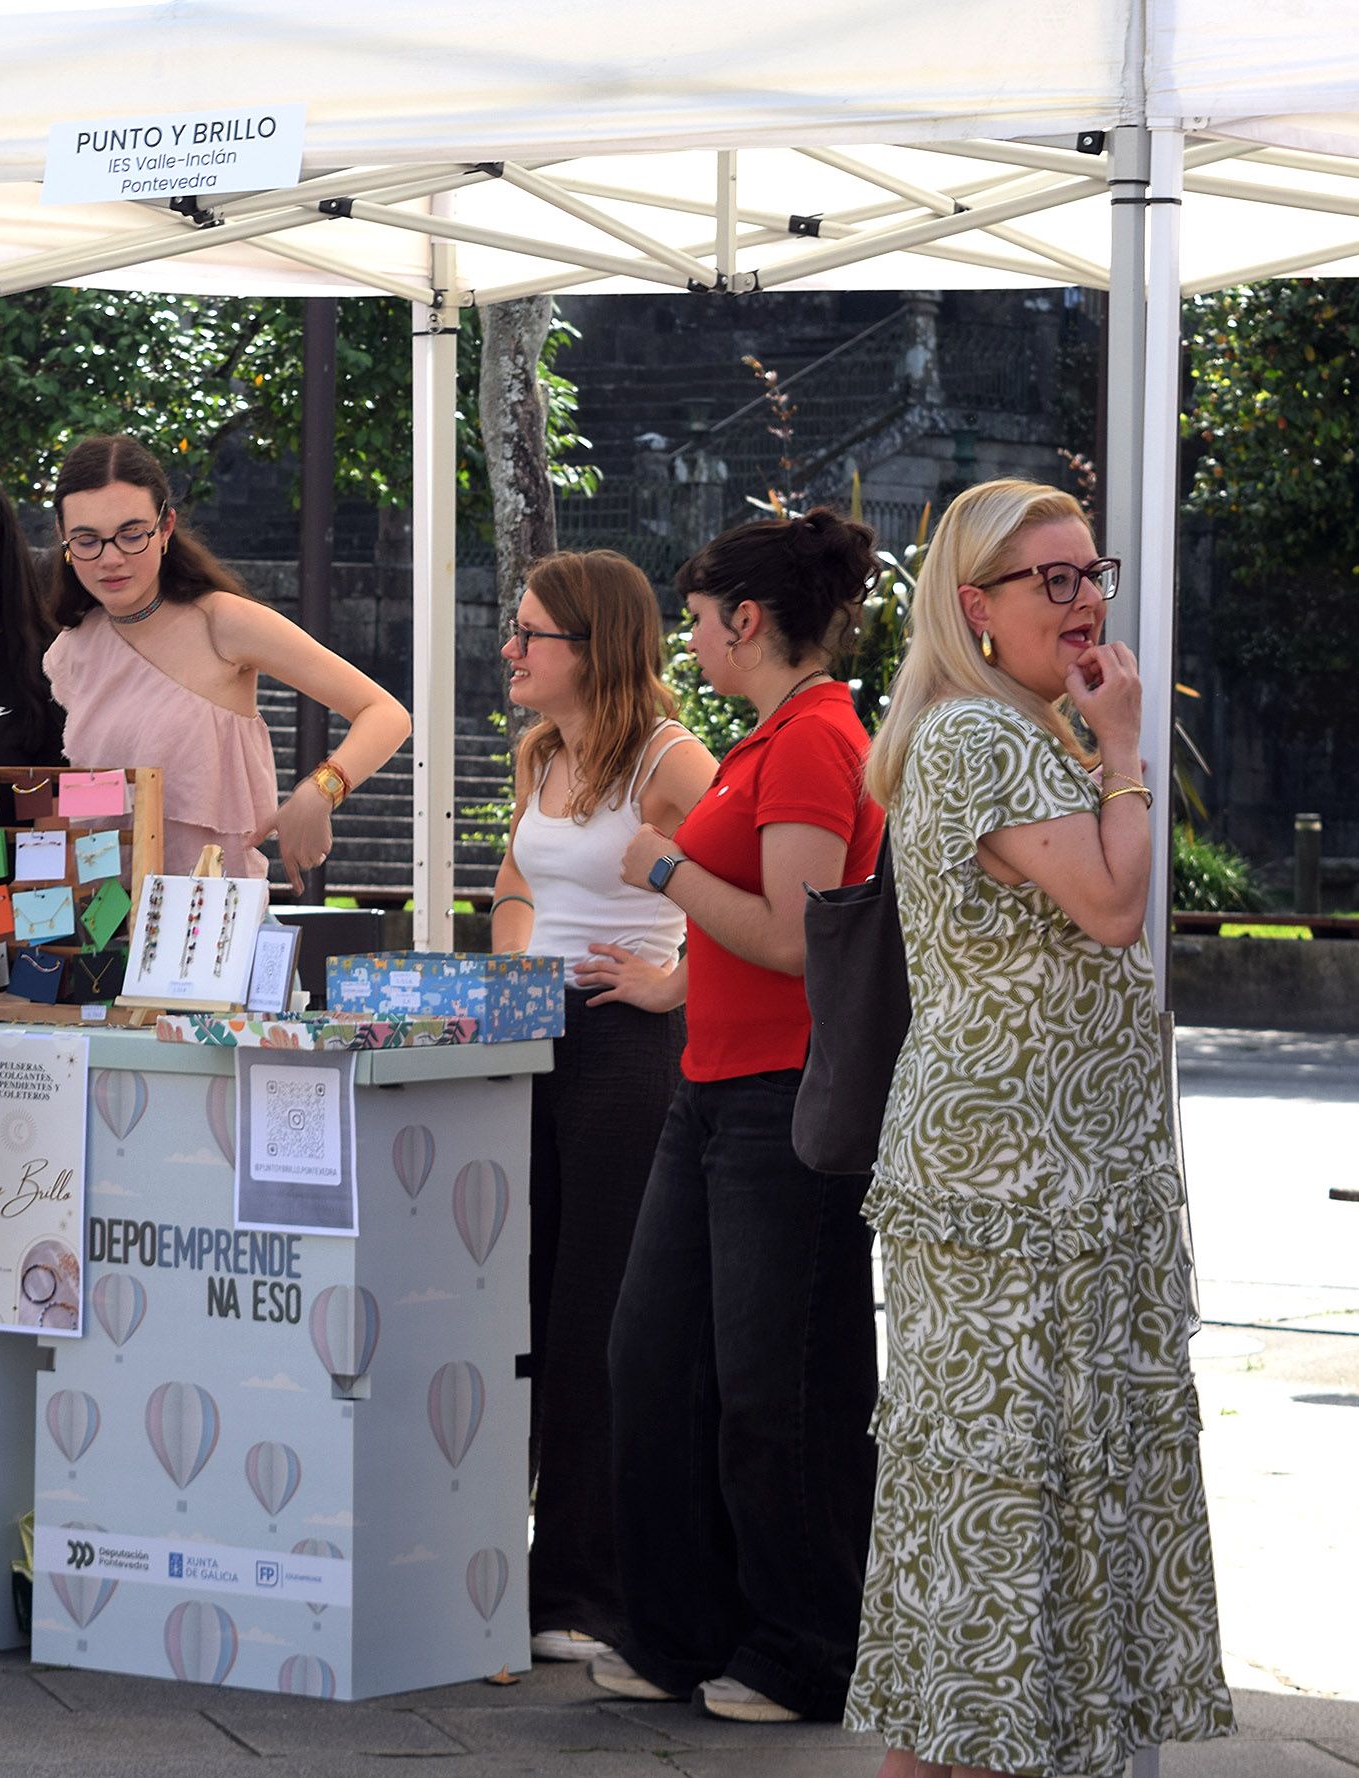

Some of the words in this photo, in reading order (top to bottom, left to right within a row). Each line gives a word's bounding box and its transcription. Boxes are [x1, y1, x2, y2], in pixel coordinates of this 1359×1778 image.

[76, 127, 163, 154] PUNTO
[171, 124, 187, 146] Y
[193, 116, 277, 145] BRILLO
[108, 158, 130, 174] IES
[136, 149, 237, 171] Valle-Inclán
[121, 173, 217, 194] Pontevedra
[1, 1158, 74, 1219] Brillo
[89, 1216, 303, 1279] DEPOEMPRENDE
[207, 1275, 241, 1319] NA
[252, 1279, 302, 1324] ESO
[99, 1546, 150, 1560] Deputación
[186, 1556, 219, 1568] XUNTA
[98, 1557, 150, 1571] Pontevedra
[259, 1566, 274, 1581] FP
[186, 1568, 198, 1578] DE
[200, 1569, 239, 1583] GALICIA
